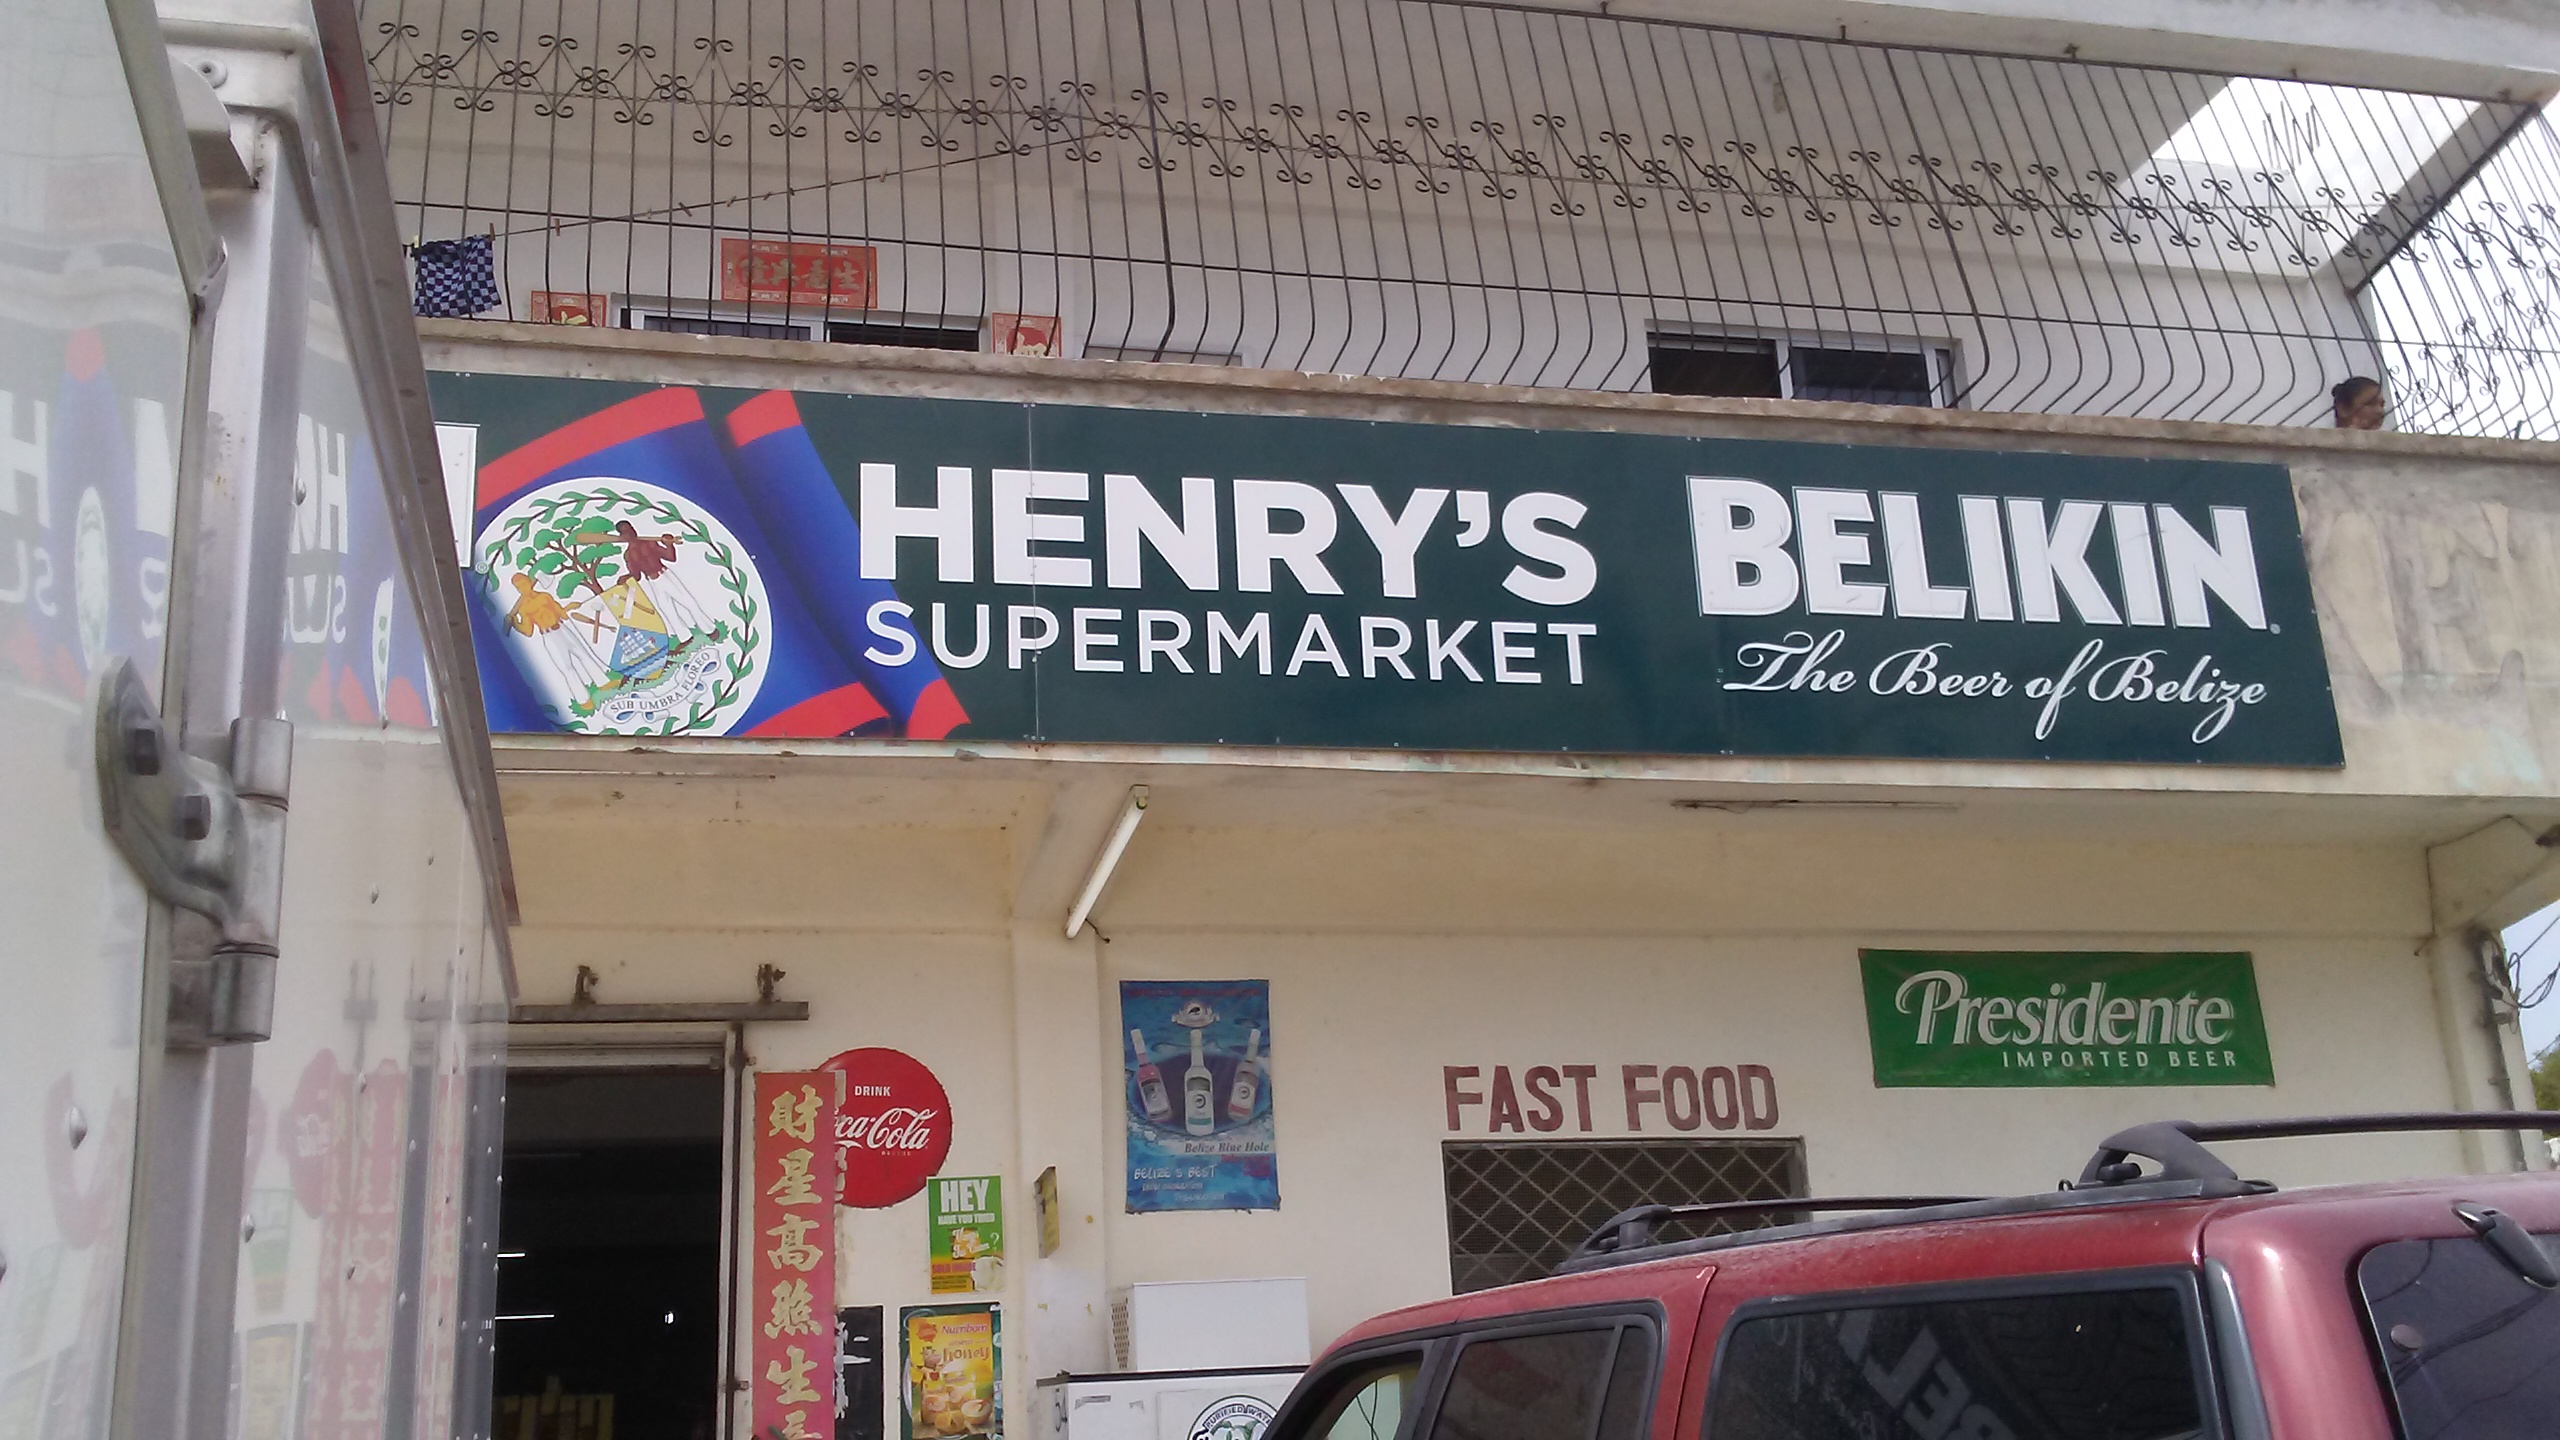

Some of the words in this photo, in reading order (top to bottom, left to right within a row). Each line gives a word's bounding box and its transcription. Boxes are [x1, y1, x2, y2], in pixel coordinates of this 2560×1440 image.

[860, 462, 1598, 605] HENRY'S
[1686, 475, 2268, 630] BELIKIN
[863, 600, 1597, 685] SUPERMARKET
[611, 701, 634, 712] SUB
[640, 692, 683, 711] UMBRA
[682, 652, 710, 691] FLOREO
[1722, 629, 1856, 692] The
[1869, 642, 2012, 698] Beer
[2025, 639, 2104, 741] of
[2088, 650, 2267, 744] Belize
[1894, 969, 2235, 1047] Presidente
[2002, 1050, 2149, 1067] IMPORTED
[2169, 1050, 2236, 1067] BEER
[854, 1085, 891, 1097] DRINK
[1442, 1064, 1597, 1134] FAST
[1621, 1064, 1781, 1132] FOOD
[1184, 1141, 1215, 1153] Belize
[1218, 1141, 1242, 1152] Blue
[1245, 1141, 1270, 1152] Hole
[940, 1179, 989, 1213] HEY
[943, 1346, 990, 1362] honey
[1206, 1406, 1244, 1429] PURIFIED
